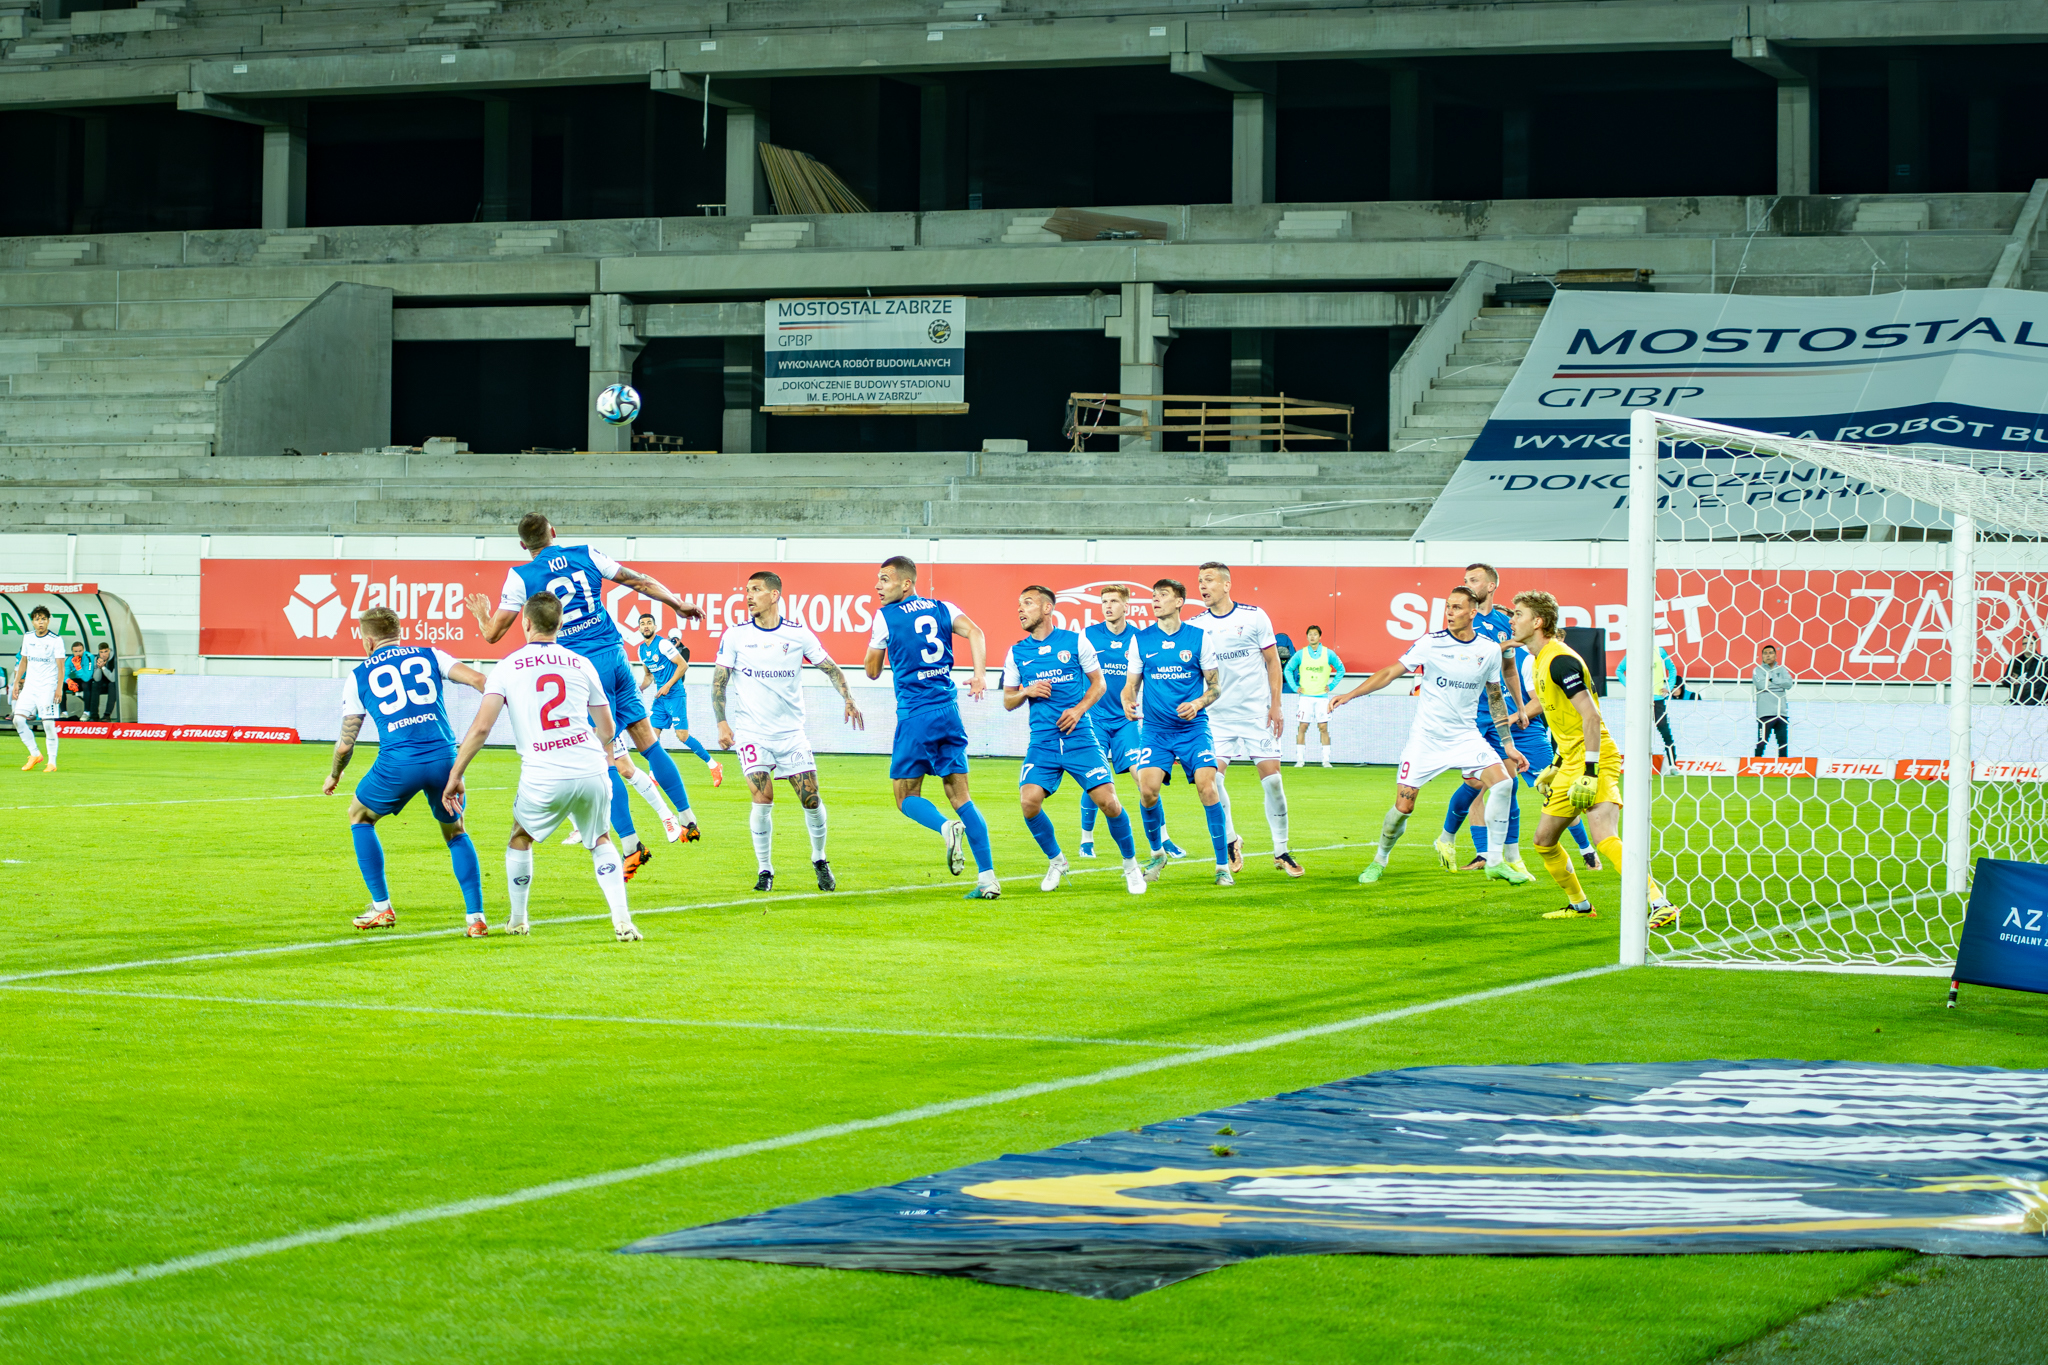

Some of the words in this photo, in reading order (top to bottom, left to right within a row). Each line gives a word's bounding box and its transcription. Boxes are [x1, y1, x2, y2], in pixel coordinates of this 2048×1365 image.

[778, 300, 881, 317] MOSTOSTAL
[885, 299, 953, 315] ZABRZE
[778, 334, 813, 347] GPBP
[1567, 317, 2048, 356] MOSTOSTAL
[778, 359, 841, 370] WYKONAWCA
[843, 358, 875, 369] ROBÓT
[876, 358, 951, 368] BUDOWLANYCH
[854, 380, 898, 389] BUDOWY
[900, 379, 951, 389] STADIONU
[806, 393, 820, 402] IM.
[822, 393, 832, 401] E.
[832, 392, 864, 401] POHLA
[867, 392, 876, 401] W
[1538, 386, 1705, 408] GPBP
[1833, 415, 1994, 442] ROBÓT
[1746, 483, 1886, 505] POHL
[548, 556, 569, 573] KOJ
[43, 584, 84, 593] SUPERBET
[351, 574, 464, 620] Zabrze
[546, 570, 597, 625] 21
[1, 612, 106, 636] AZE
[415, 620, 464, 644] Śląska
[563, 615, 602, 637] TERMOFOL
[914, 615, 945, 664] 3
[364, 646, 420, 669] POCZOBUT
[1104, 662, 1127, 670] MIASTO
[754, 669, 795, 680] WĘGLOKOKS
[1036, 668, 1063, 679] MIASTO
[1157, 665, 1183, 673] MIASTO
[368, 656, 438, 716] 93
[536, 673, 571, 731] 2
[393, 713, 438, 730] TERMOFOL
[62, 726, 109, 736] STRAUSS
[122, 728, 168, 739] STRAUSS
[182, 728, 228, 739] STRAUSS
[243, 730, 291, 741] STRAUSS
[532, 732, 589, 752] SUPERBET
[740, 744, 758, 766] 13
[1400, 761, 1410, 780] 9
[1675, 760, 1728, 772] STIHL
[1747, 762, 1805, 775] STIHL
[1826, 763, 1884, 775] STIHL
[1984, 765, 2043, 778] STIHL
[2000, 932, 2042, 946] OFICJALNY
